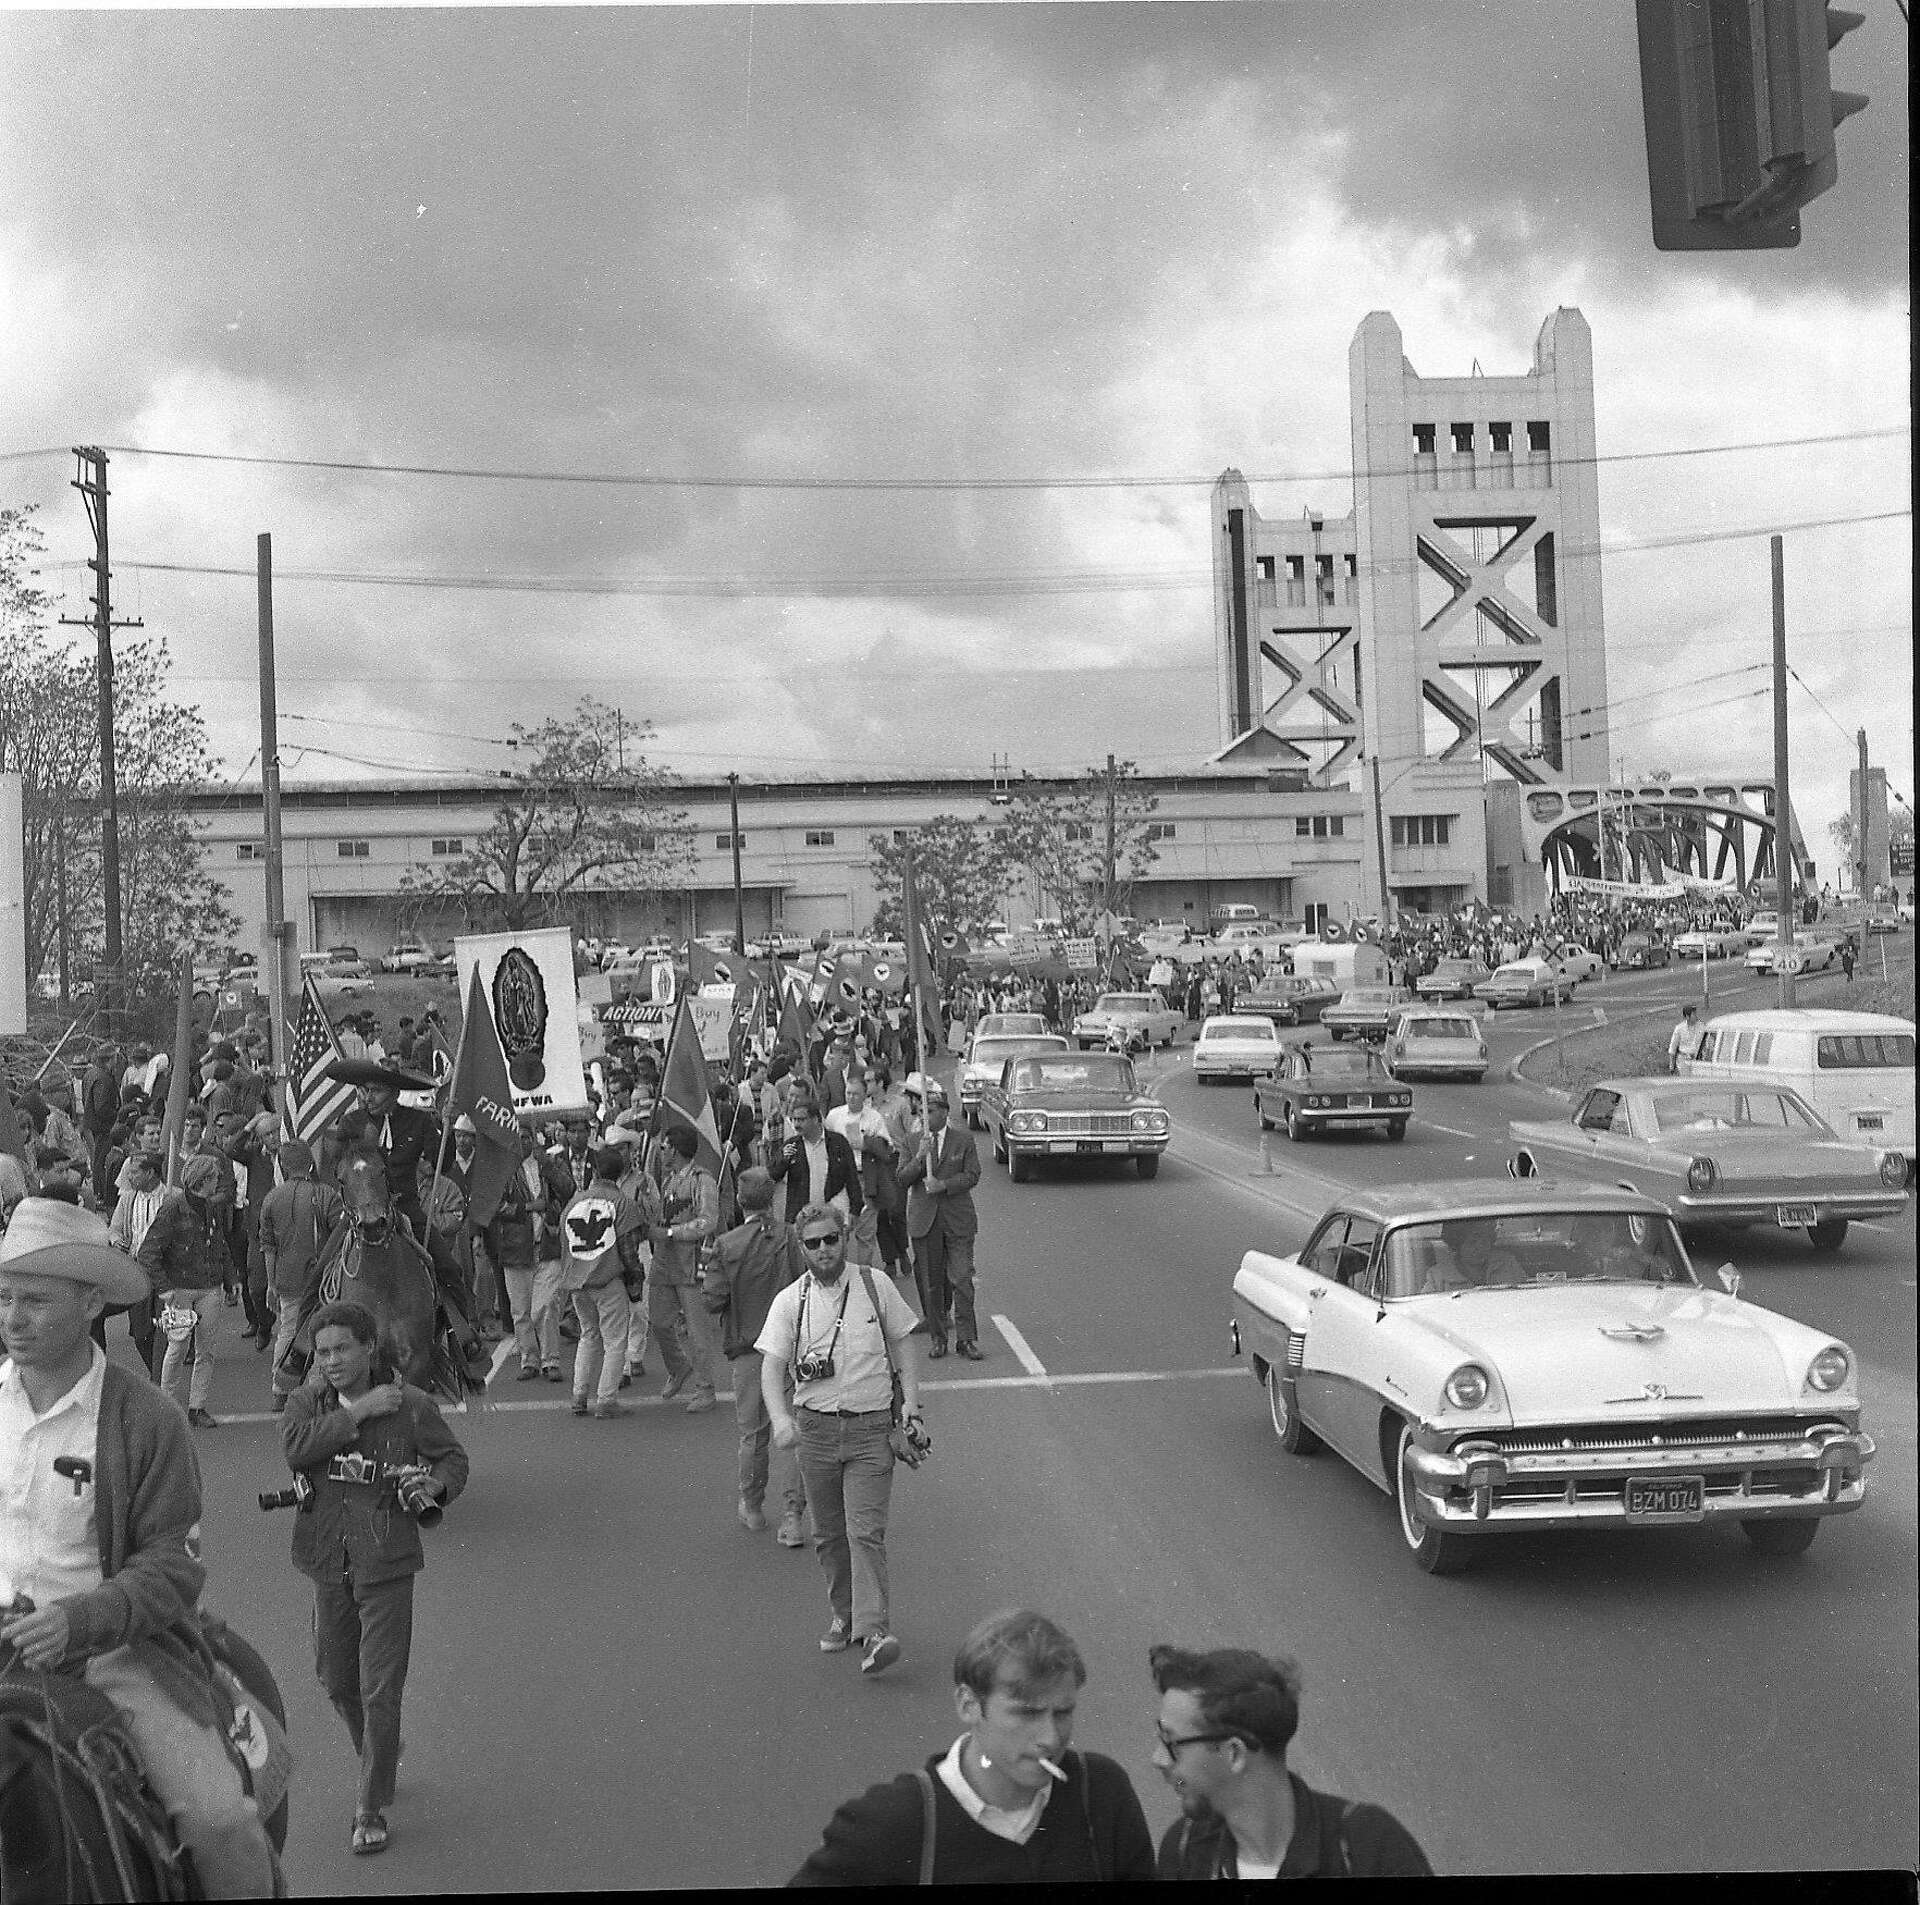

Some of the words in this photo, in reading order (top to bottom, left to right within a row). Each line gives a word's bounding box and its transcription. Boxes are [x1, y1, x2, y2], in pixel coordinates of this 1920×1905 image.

[1778, 959, 1797, 970] 40
[603, 1005, 662, 1021] ACTION!
[695, 1007, 720, 1023] Buy
[1669, 1490, 1698, 1510] 074
